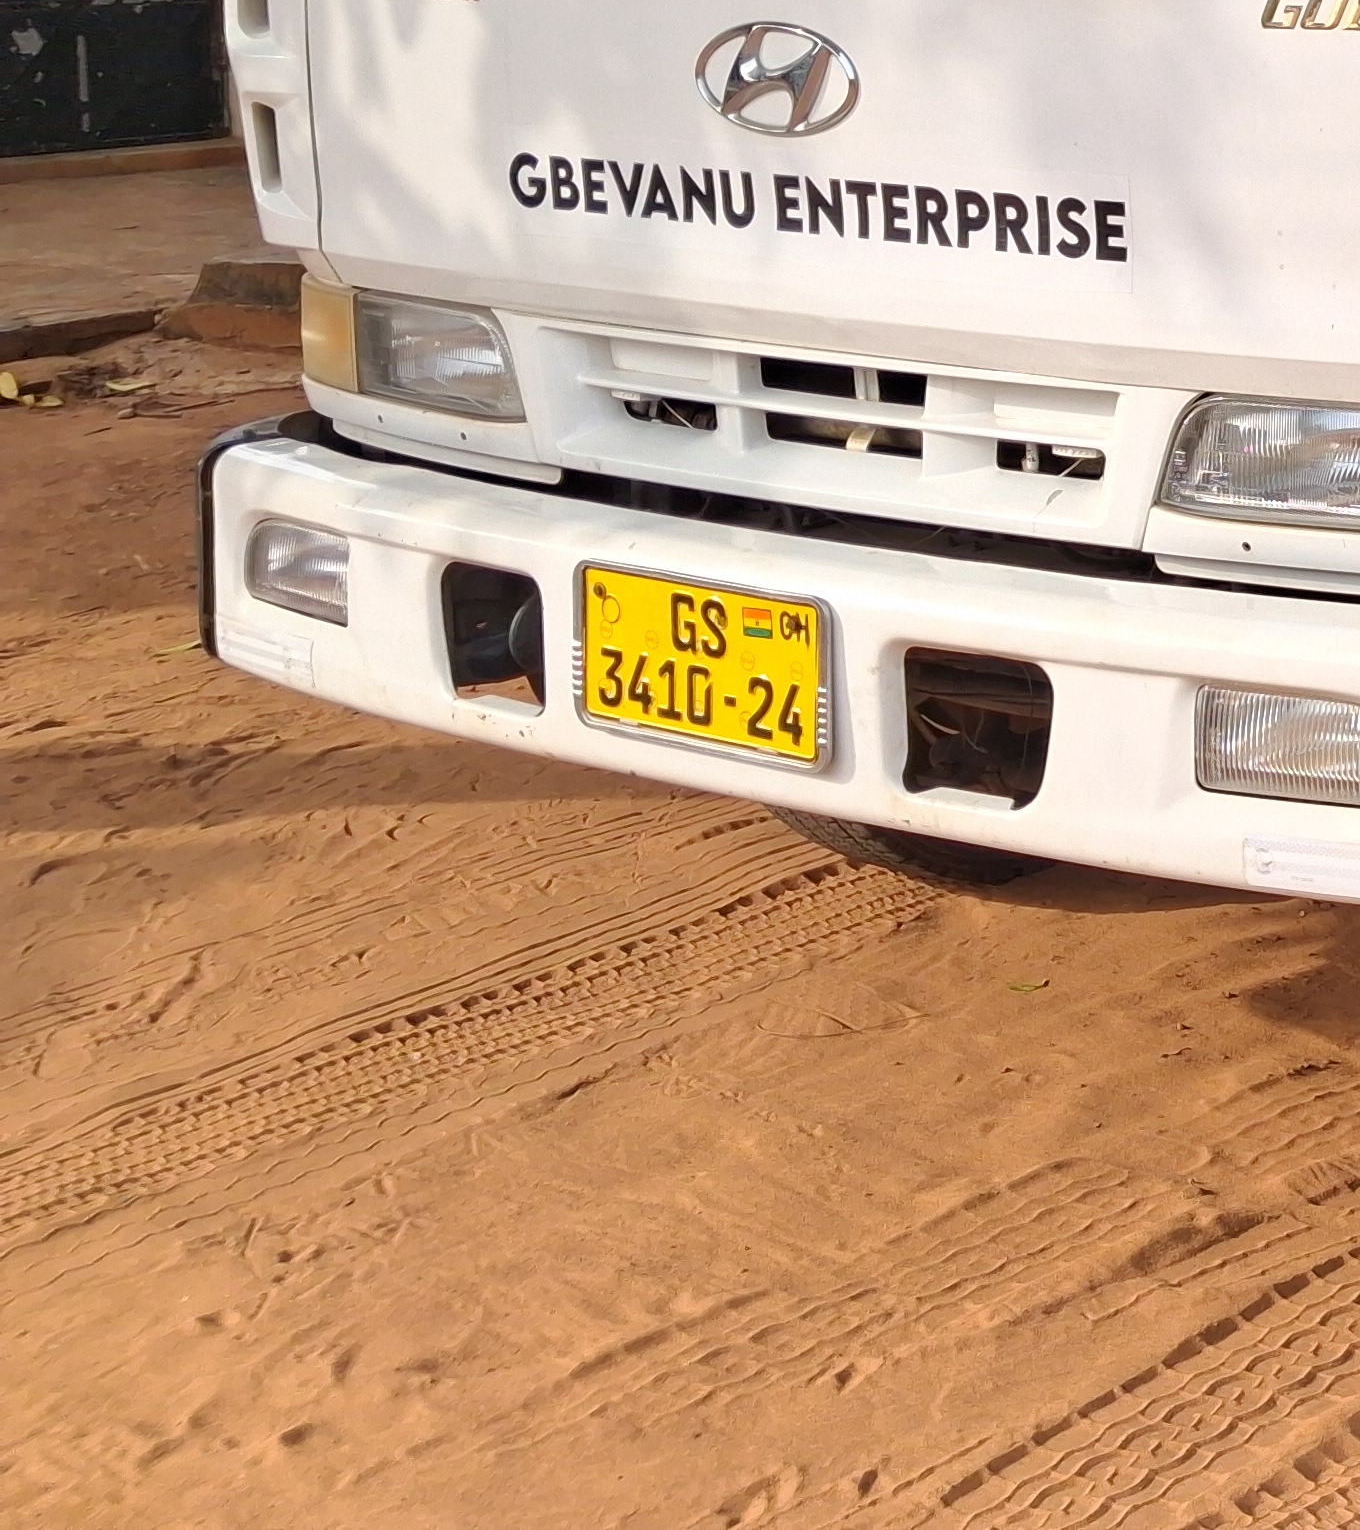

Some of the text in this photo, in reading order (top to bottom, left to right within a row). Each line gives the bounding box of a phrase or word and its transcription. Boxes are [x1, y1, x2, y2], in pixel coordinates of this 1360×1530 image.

[508, 151, 1130, 263] GBEVANU ENTERPRISE
[670, 592, 729, 660] GS
